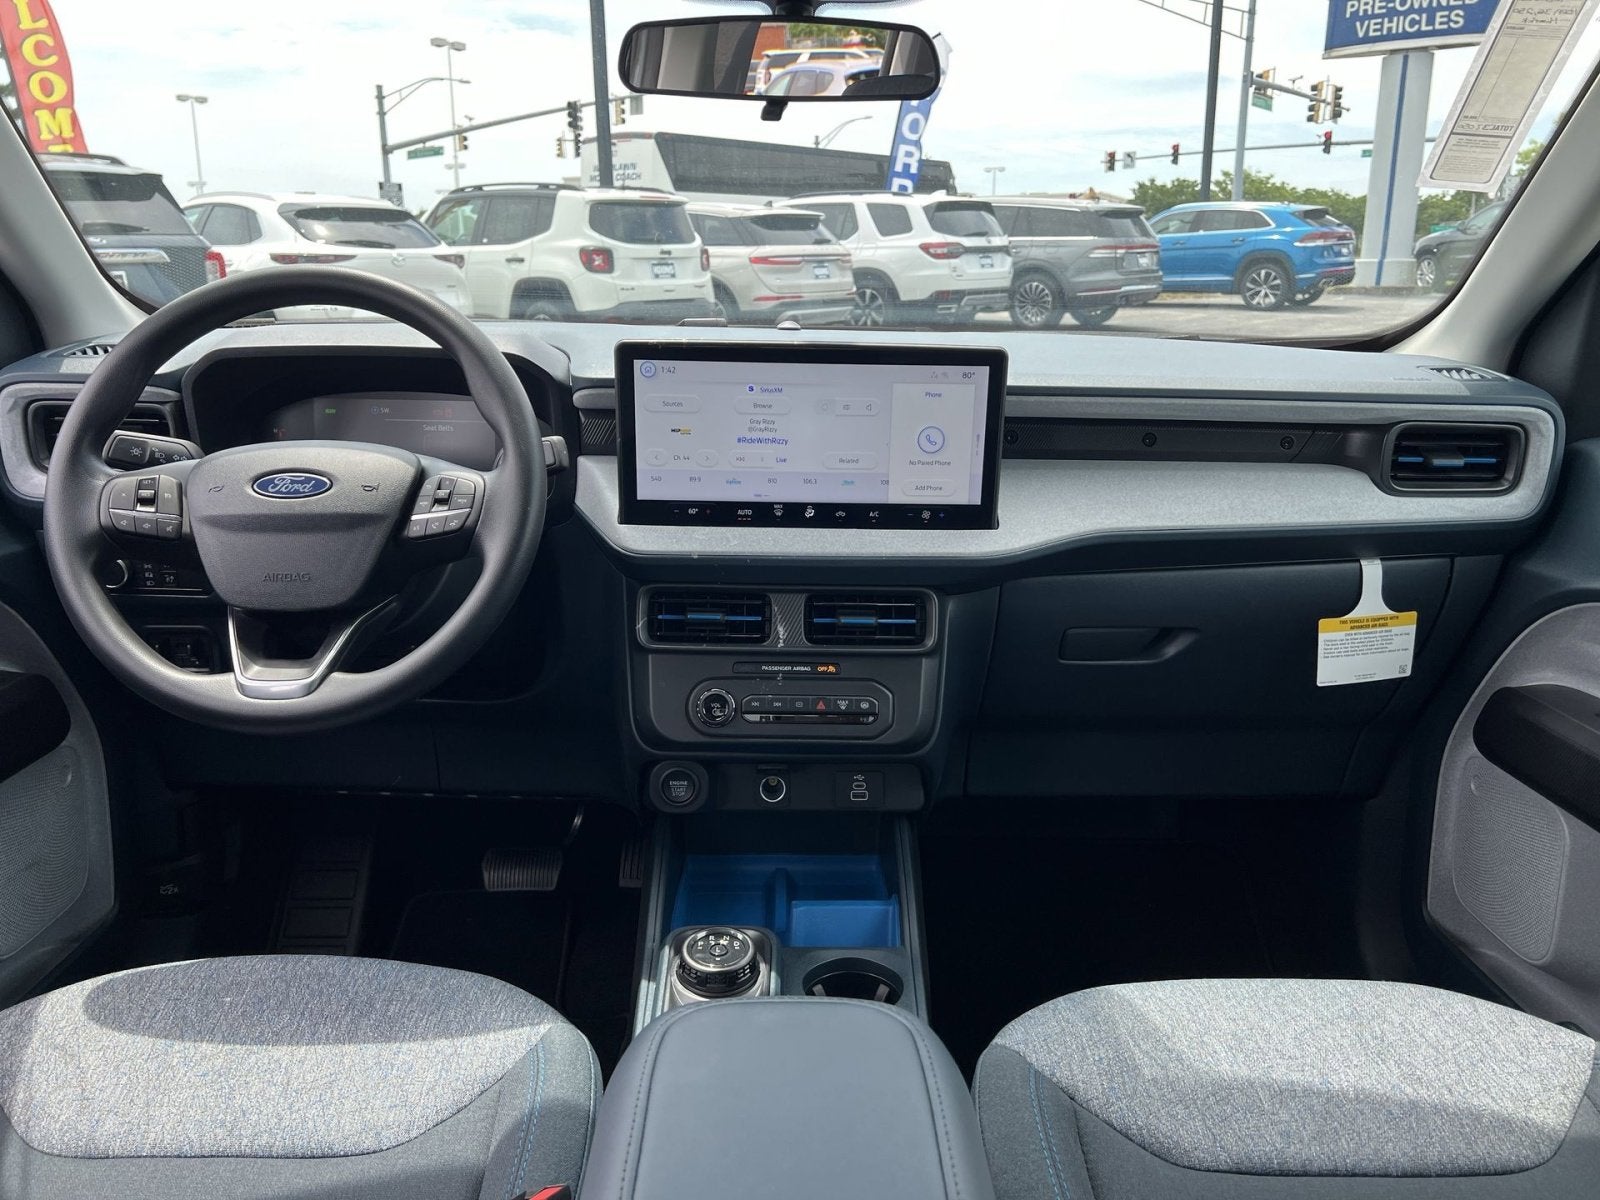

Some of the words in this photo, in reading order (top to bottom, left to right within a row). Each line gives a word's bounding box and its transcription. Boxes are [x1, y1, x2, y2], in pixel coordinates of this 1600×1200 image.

[1355, 9, 1465, 38] VEHICLES
[11, 0, 75, 154] LCOM
[890, 100, 926, 195] ORD
[661, 366, 676, 374] 1:42
[662, 400, 684, 408] Sources
[736, 436, 789, 446] #RideWithRizzy
[838, 457, 860, 465] Related
[918, 459, 934, 467] Paired
[935, 459, 952, 467] Phone
[268, 475, 316, 493] Ford
[262, 572, 311, 582] AIRBAG
